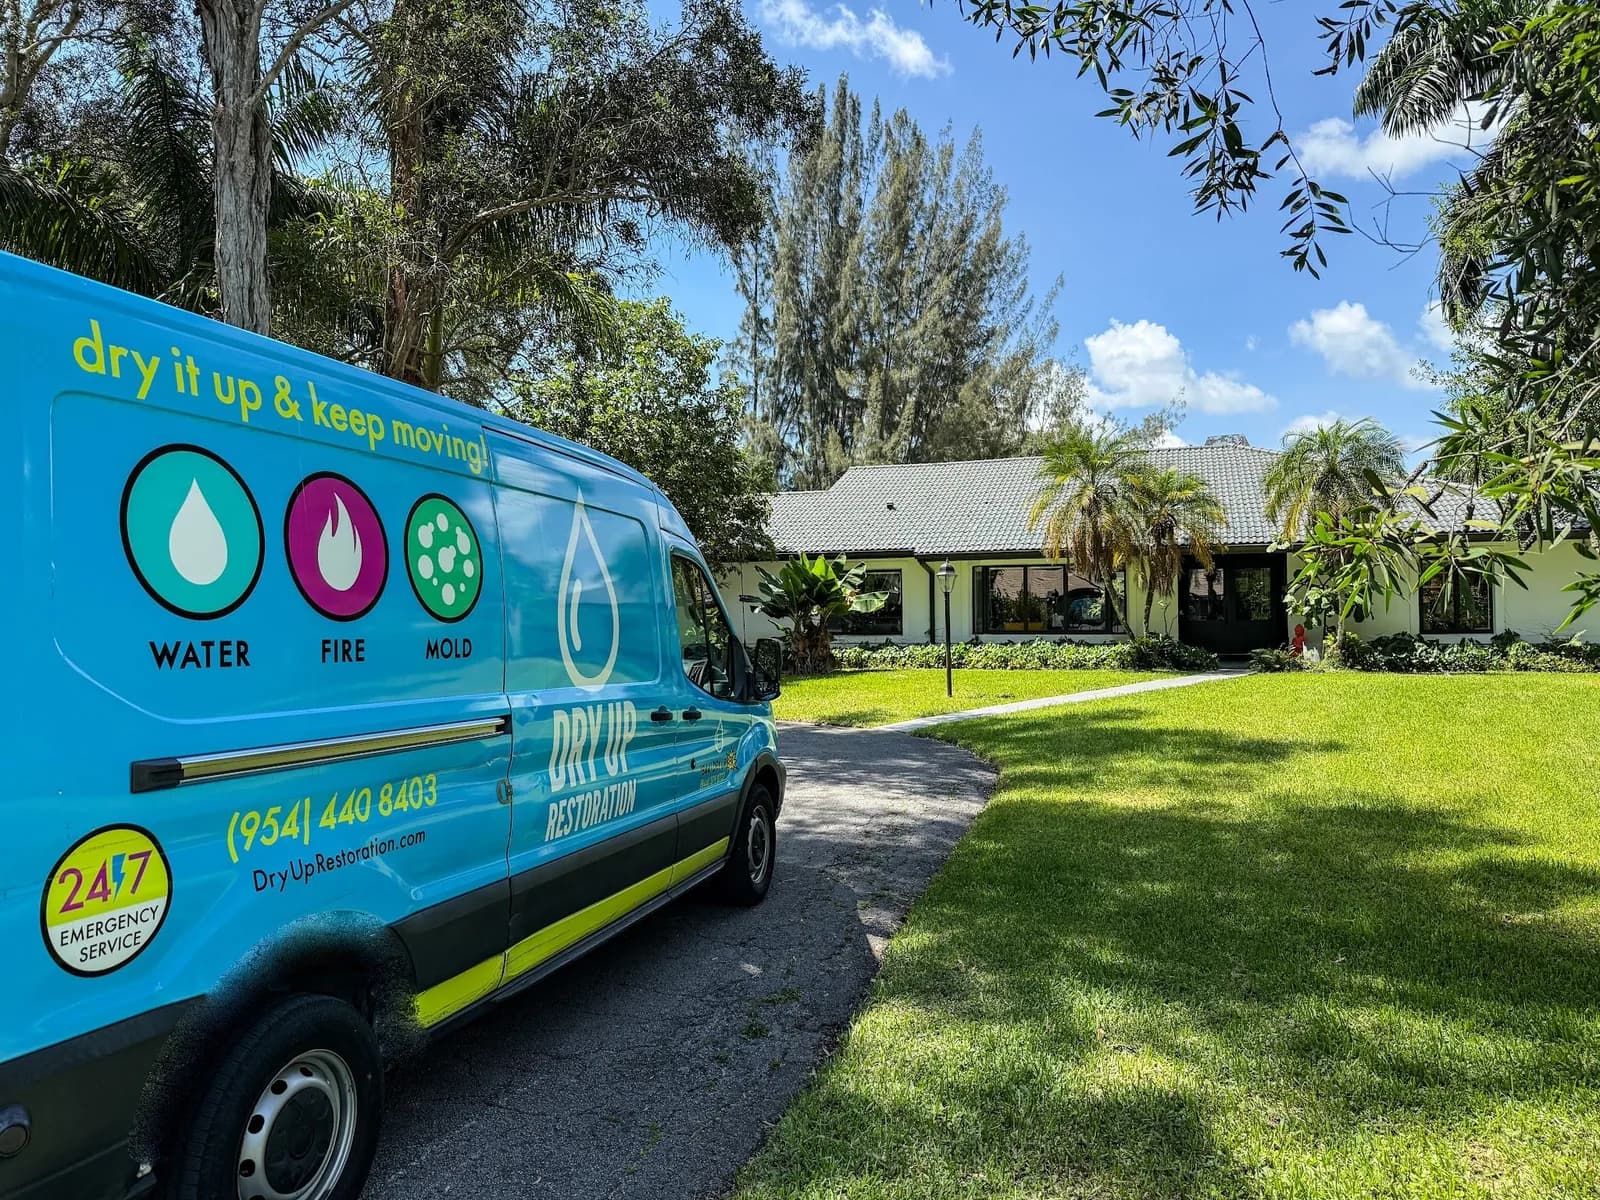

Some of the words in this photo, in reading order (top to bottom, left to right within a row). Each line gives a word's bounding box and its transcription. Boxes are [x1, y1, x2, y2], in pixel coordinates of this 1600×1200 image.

[73, 319, 160, 400] dry
[171, 346, 200, 397] it
[213, 371, 262, 423] up
[274, 375, 303, 421] &
[307, 381, 385, 451] keep
[392, 419, 489, 475] moving!
[149, 640, 251, 671] WATER
[321, 639, 366, 663] FIRE
[425, 638, 473, 660] MOLD
[549, 703, 603, 793] DRY
[604, 700, 637, 777] UP
[319, 787, 371, 830] 440
[378, 773, 437, 818] 8403
[544, 778, 637, 842] RESTORATION
[252, 830, 426, 892] DryUpRestoration.com
[60, 905, 159, 947] EMERGENCY
[79, 931, 142, 963] SERVICE
